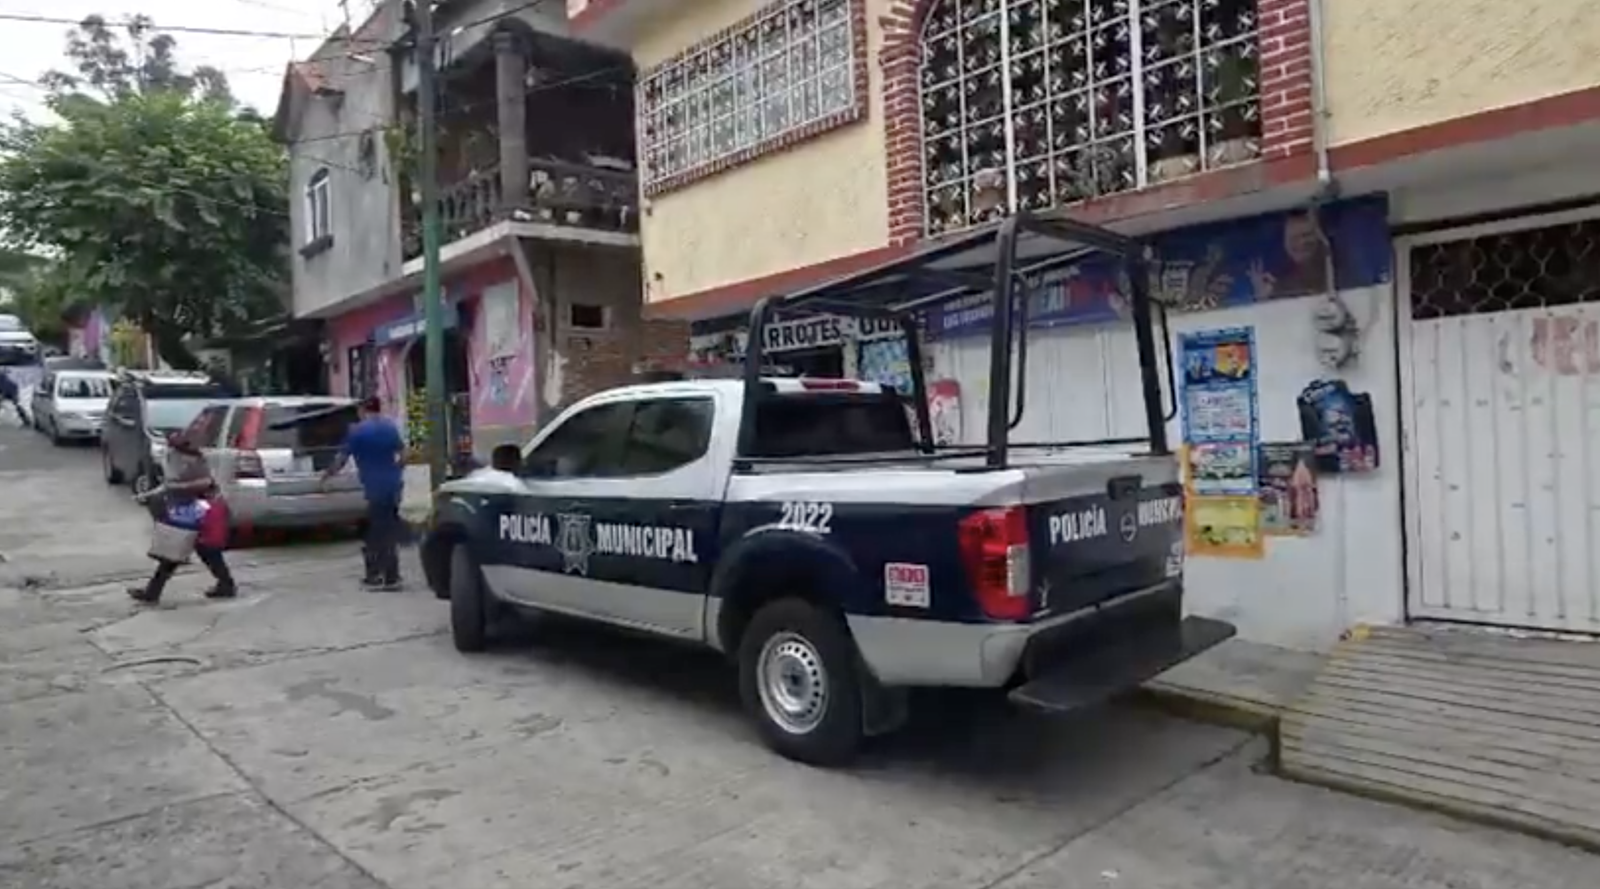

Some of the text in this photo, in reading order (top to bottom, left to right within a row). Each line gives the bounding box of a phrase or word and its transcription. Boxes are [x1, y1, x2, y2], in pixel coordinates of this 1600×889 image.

[500, 513, 698, 562] POLICÍA MUNICIPAL
[781, 501, 833, 534] 2022
[1049, 503, 1107, 545] POLICÍA
